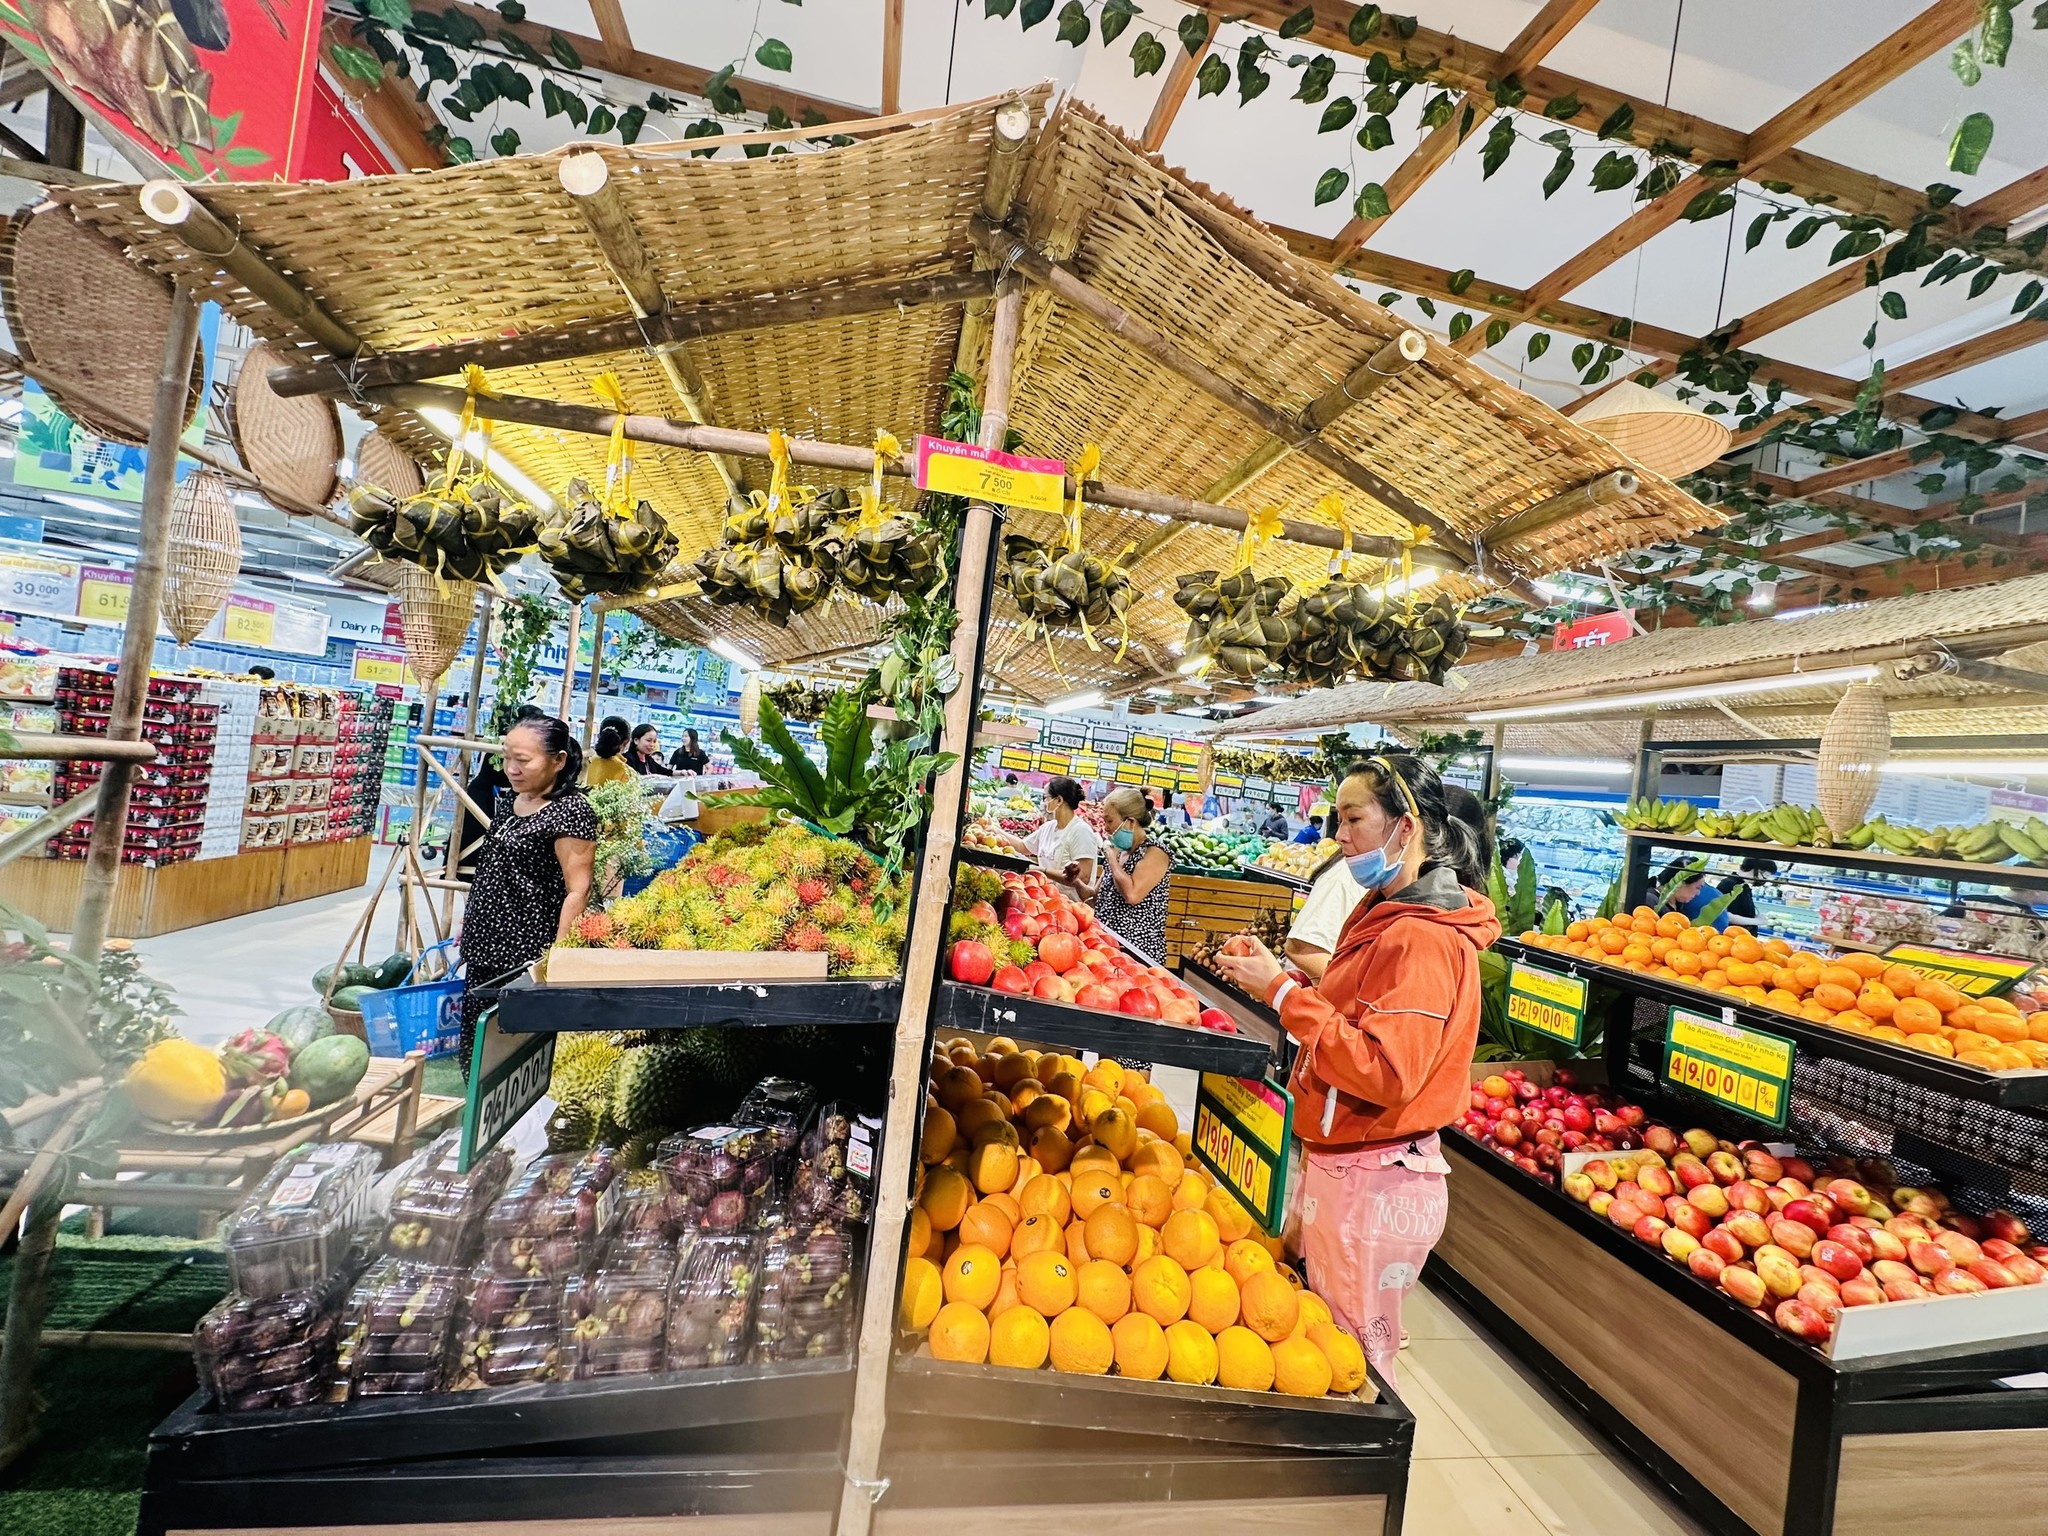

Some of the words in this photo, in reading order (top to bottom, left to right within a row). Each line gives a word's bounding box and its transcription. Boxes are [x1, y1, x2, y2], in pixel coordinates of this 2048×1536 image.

[928, 439, 967, 456] Khuyến
[994, 477, 1012, 490] 500
[84, 568, 121, 584] Khuyến
[341, 620, 367, 633] Dairy
[1509, 997, 1561, 1028] 52.900
[1697, 1027, 1724, 1041] Autumn
[1725, 1036, 1744, 1048] Glory
[1776, 1052, 1786, 1062] kg
[1671, 1057, 1753, 1101] 49.000
[1199, 1112, 1254, 1189] 79.900
[1391, 1195, 1417, 1213] FEET
[1378, 1201, 1442, 1237] FOLLOW
